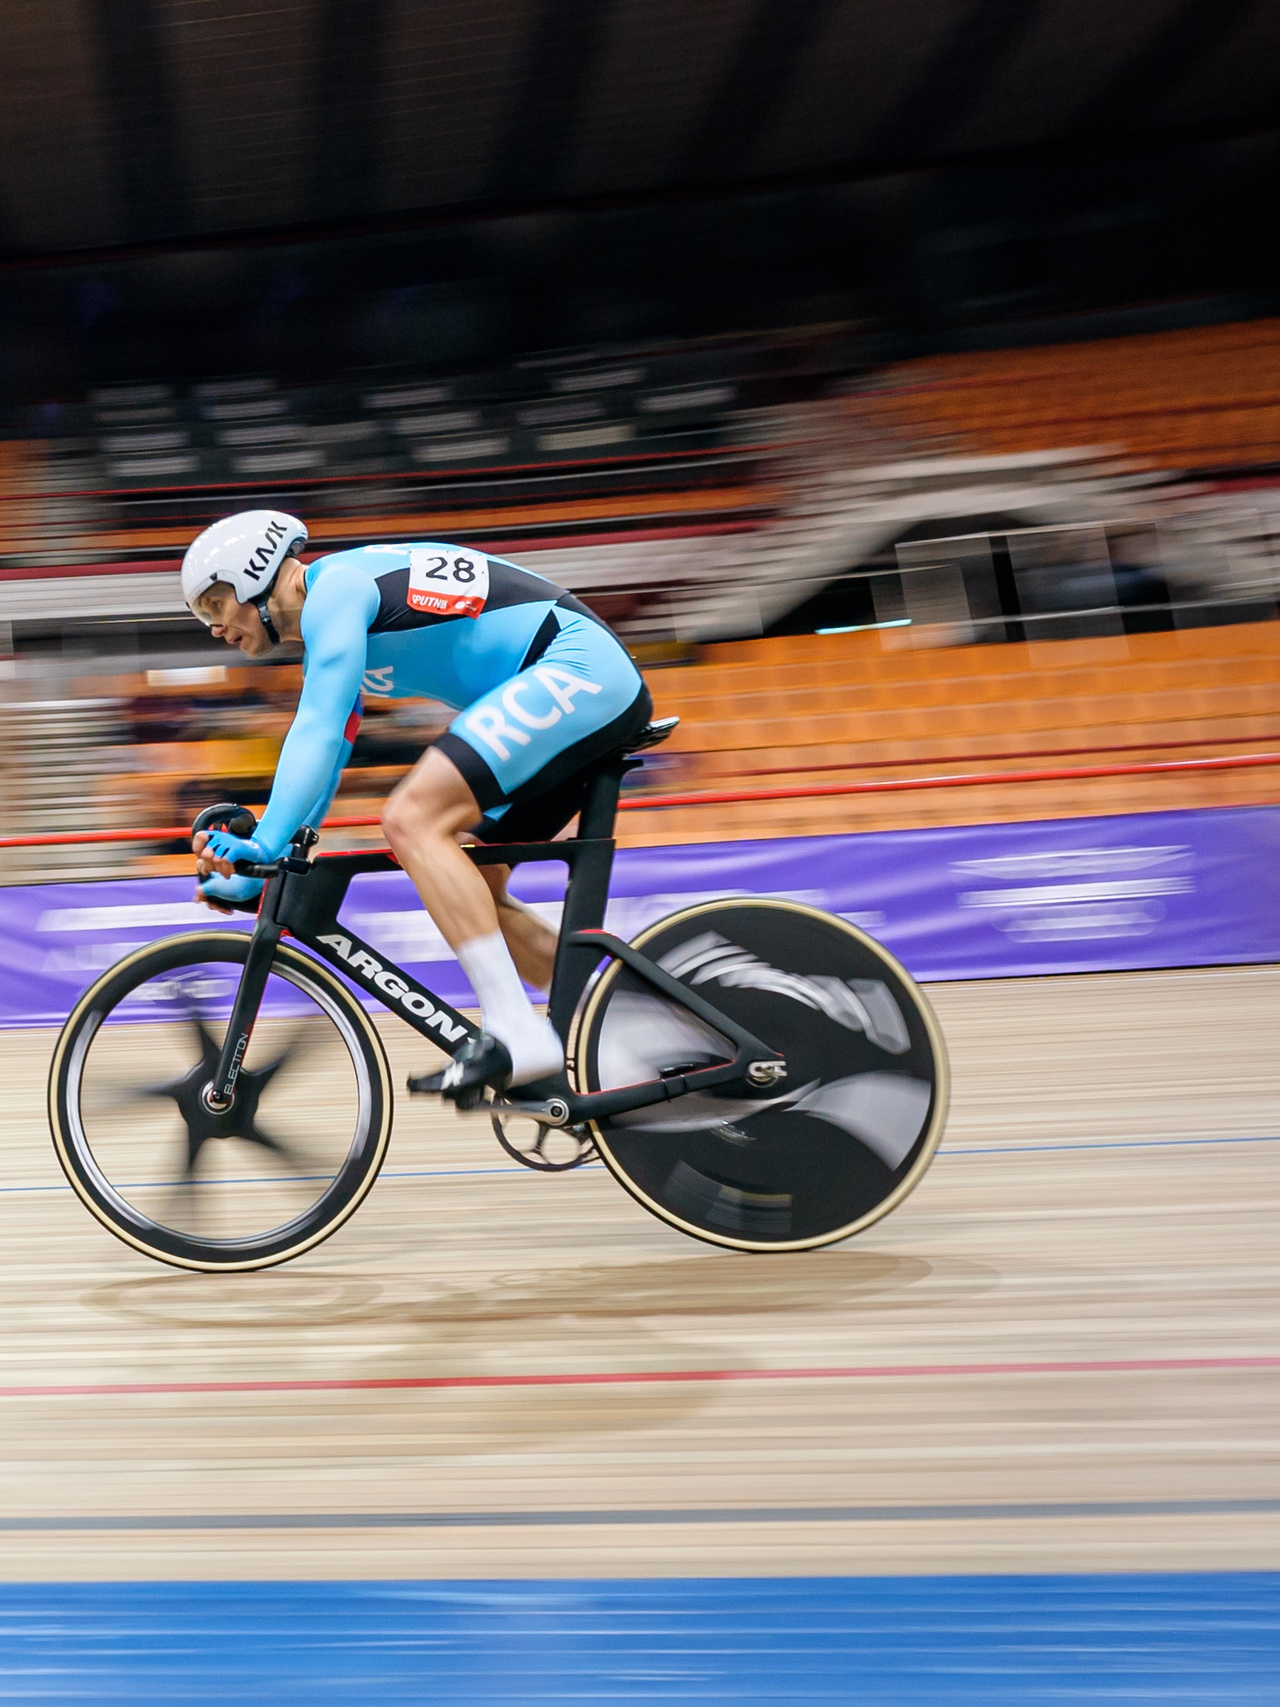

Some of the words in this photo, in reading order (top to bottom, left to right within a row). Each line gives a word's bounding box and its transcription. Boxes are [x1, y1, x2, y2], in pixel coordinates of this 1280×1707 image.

[243, 520, 288, 581] KASK
[425, 556, 476, 583] 28
[465, 667, 603, 762] RCA
[316, 934, 468, 1043] ARGON
[223, 1032, 249, 1096] ELECTRON
